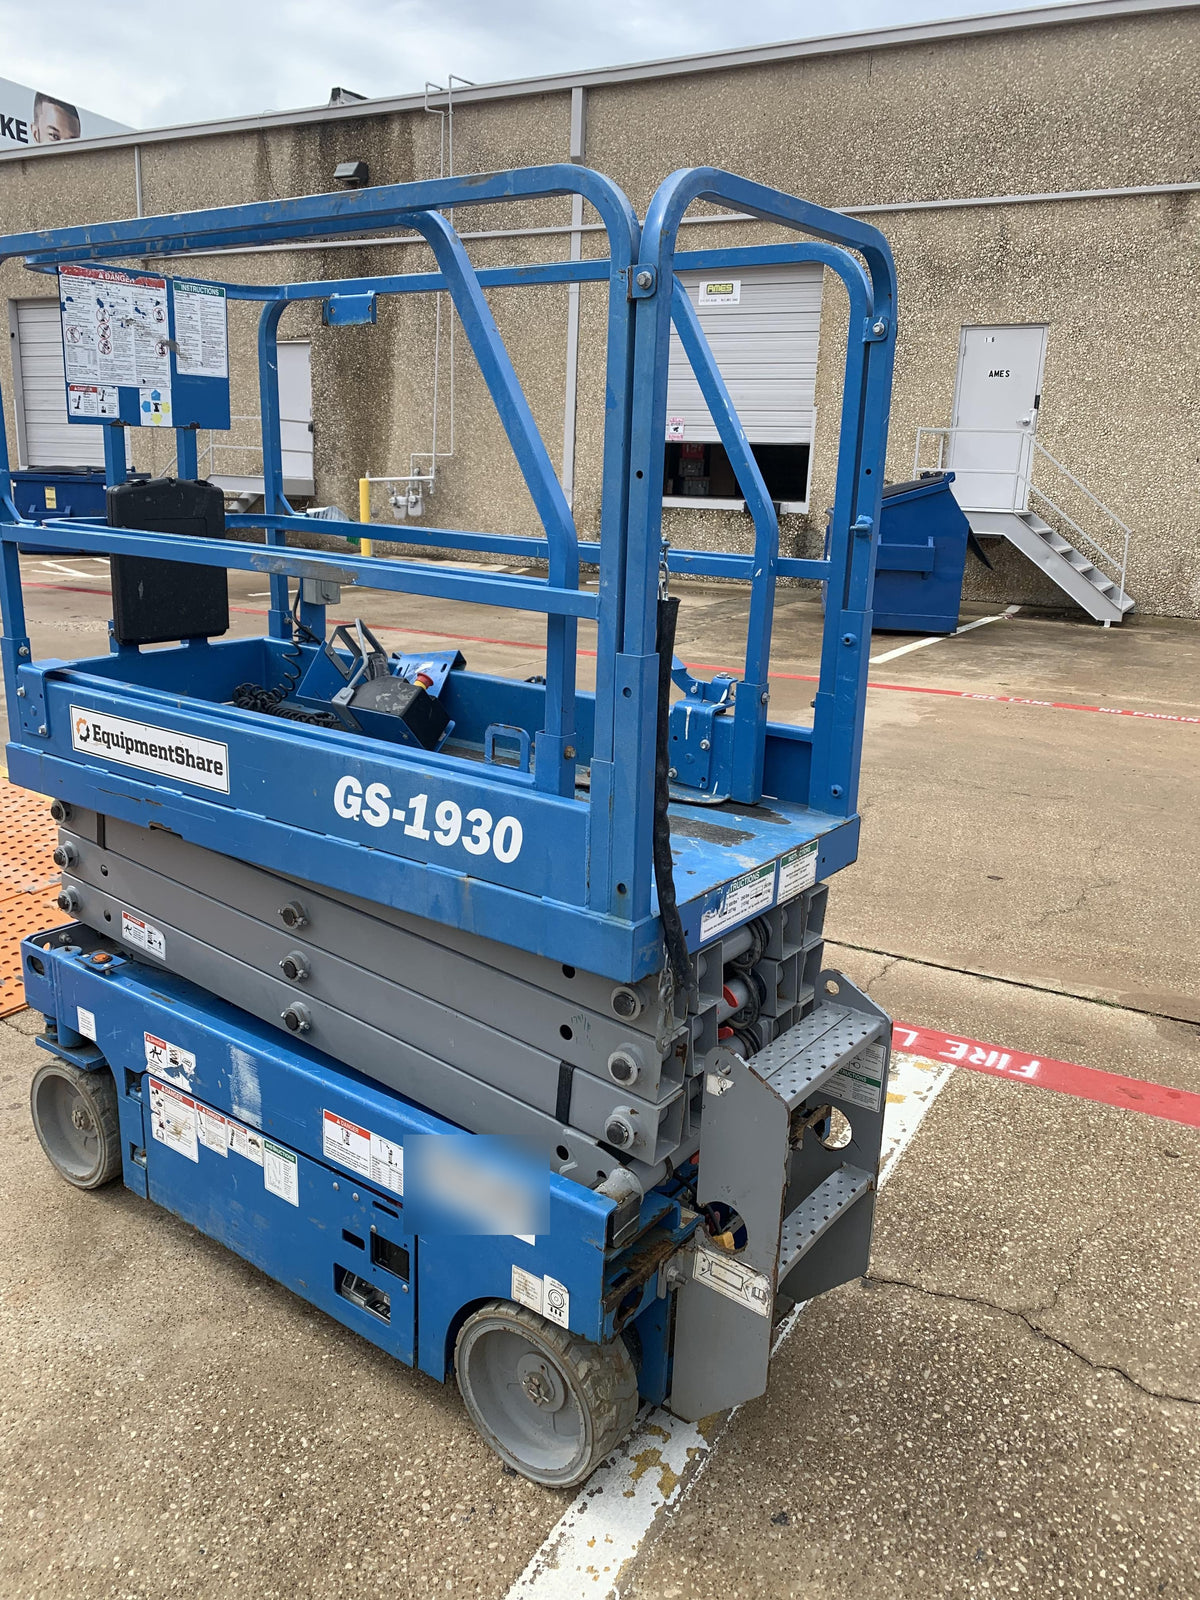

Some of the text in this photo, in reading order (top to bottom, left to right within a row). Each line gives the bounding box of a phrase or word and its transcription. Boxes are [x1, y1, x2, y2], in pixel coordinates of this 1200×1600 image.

[0, 113, 28, 144] KE
[180, 283, 220, 296] INSTRUCTIONS
[988, 369, 1011, 378] AMES
[961, 692, 997, 701] FIRE
[1008, 698, 1053, 706] LANE
[1132, 711, 1199, 722] PARKIN
[92, 724, 224, 777] EquipmentShare
[333, 775, 523, 864] GS-1930
[893, 1027, 1041, 1079] FIRE L
[164, 1087, 184, 1100] DANGER
[340, 1120, 360, 1134] DANGER
[265, 1142, 295, 1162] INSTRUCTIONS
